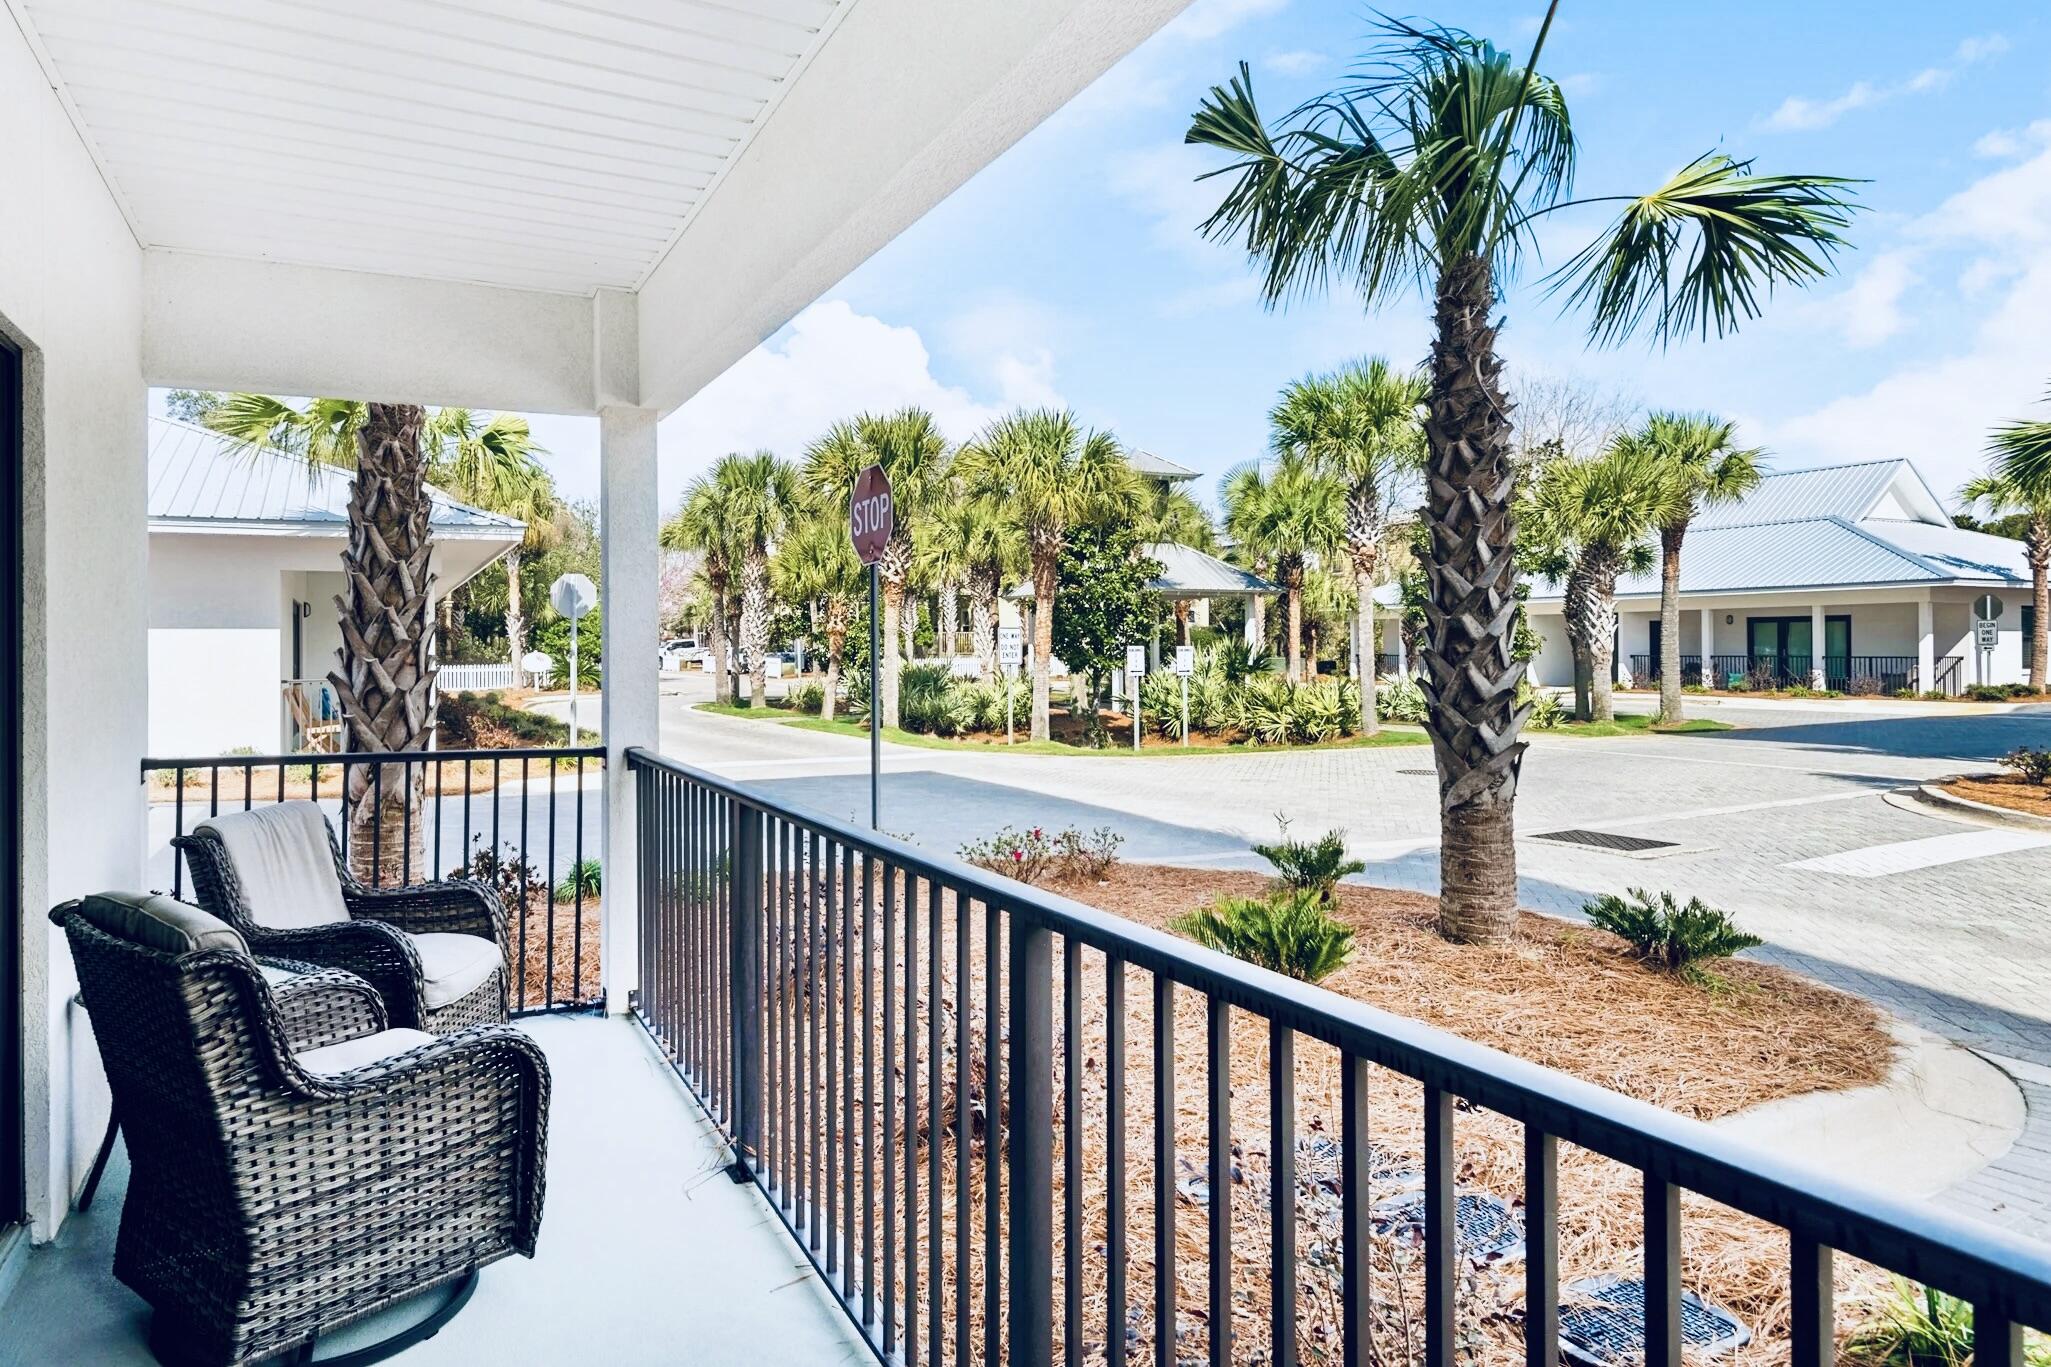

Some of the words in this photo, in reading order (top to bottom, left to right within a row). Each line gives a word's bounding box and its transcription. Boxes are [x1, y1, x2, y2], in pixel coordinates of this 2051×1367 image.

[853, 492, 889, 537] STOP
[999, 632, 1009, 640] ONE
[1000, 643, 1008, 651] DO
[1009, 643, 1020, 651] NOT
[1001, 651, 1018, 659] ENTER
